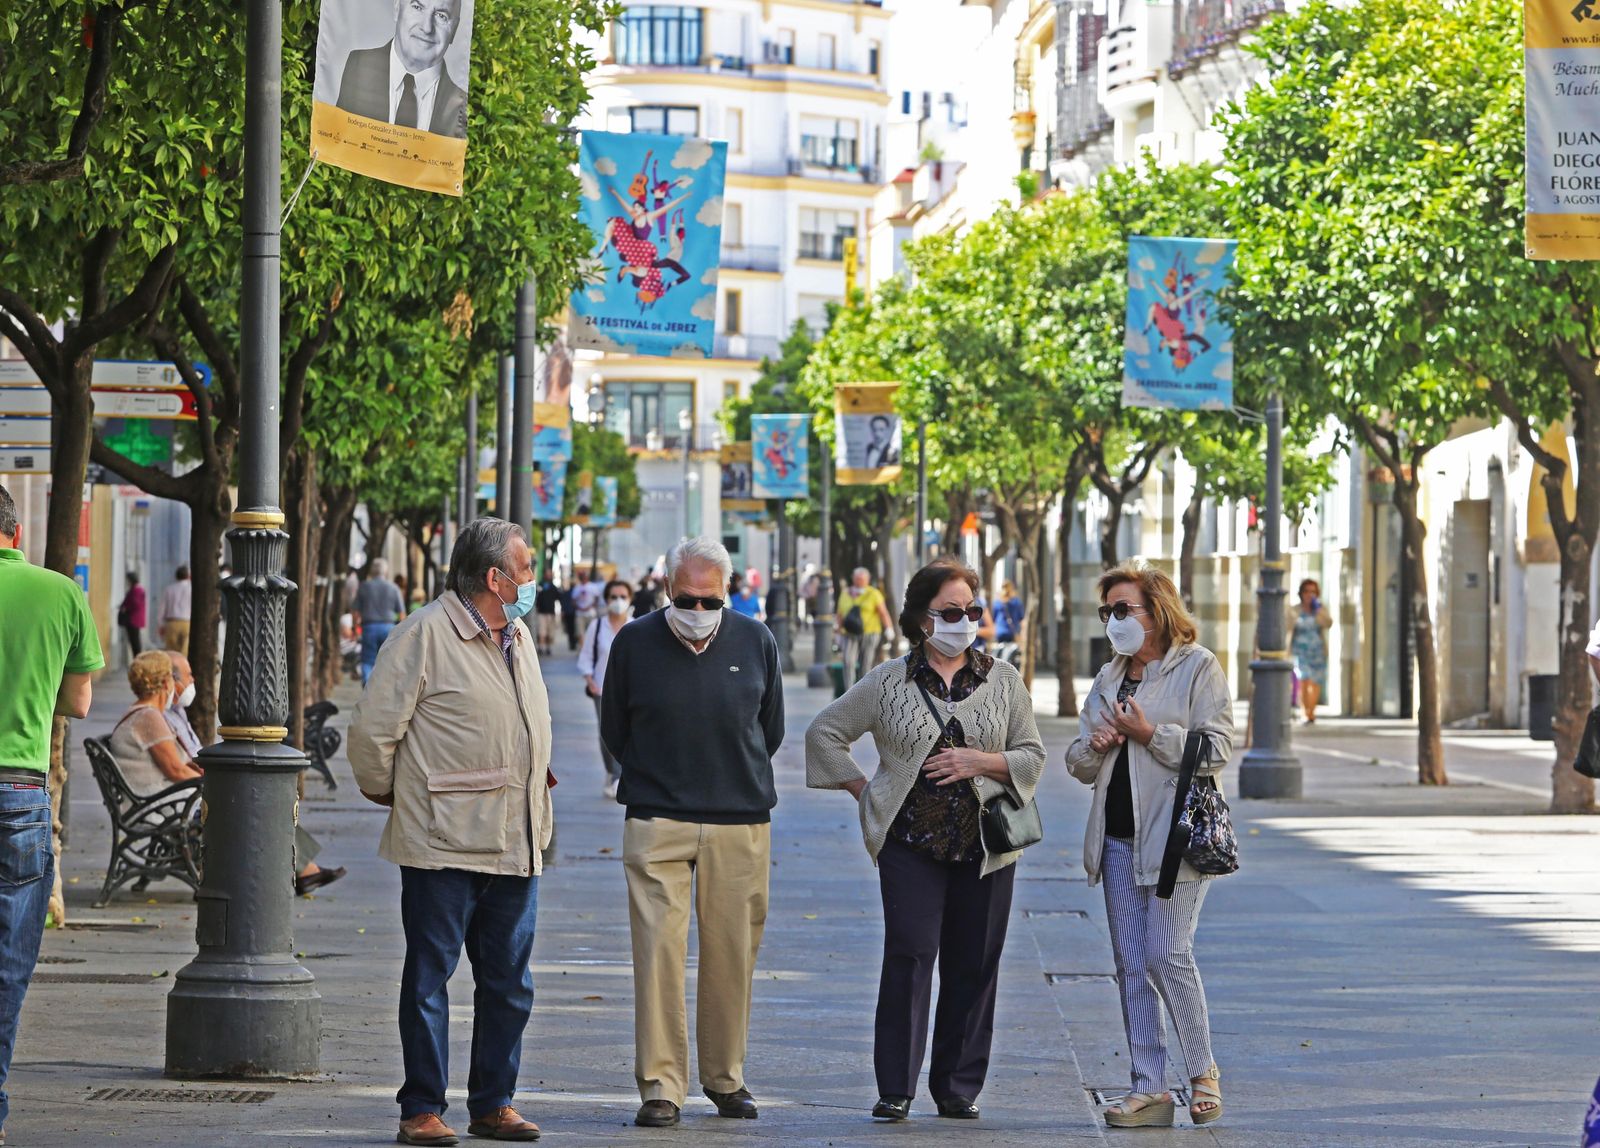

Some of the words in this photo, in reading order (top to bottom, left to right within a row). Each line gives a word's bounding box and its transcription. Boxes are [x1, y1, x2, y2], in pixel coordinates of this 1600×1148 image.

[1558, 131, 1600, 148] JUAN
[1551, 170, 1600, 190] FLÓRE
[1553, 195, 1560, 205] 3
[1563, 195, 1600, 205] AGOST
[585, 316, 598, 326] 24
[600, 317, 649, 331] FESTIVAL
[664, 322, 697, 333] JEREZ
